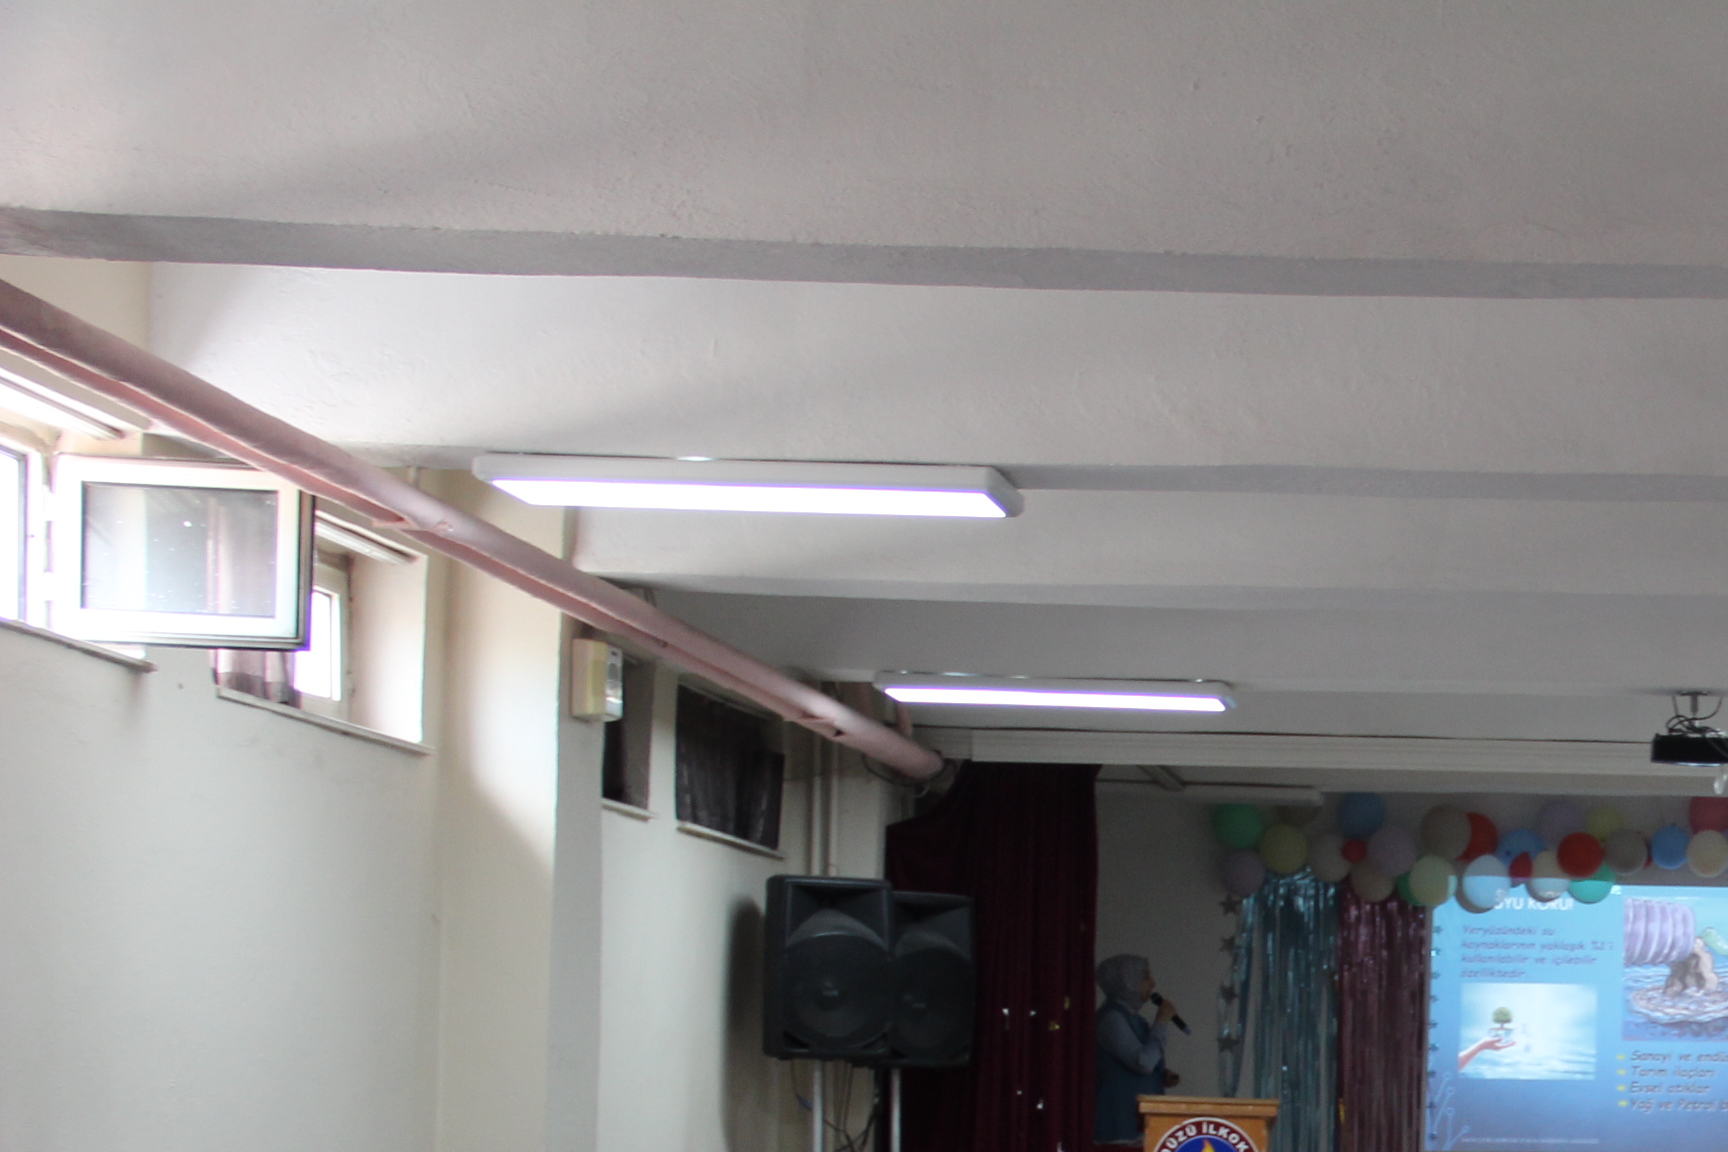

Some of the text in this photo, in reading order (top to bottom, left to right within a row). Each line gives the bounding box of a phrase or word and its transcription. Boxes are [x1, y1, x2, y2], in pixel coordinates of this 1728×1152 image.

[1631, 1050, 1672, 1064] Sanayi
[1679, 1053, 1692, 1062] ve
[1630, 1080, 1662, 1094] Evsel
